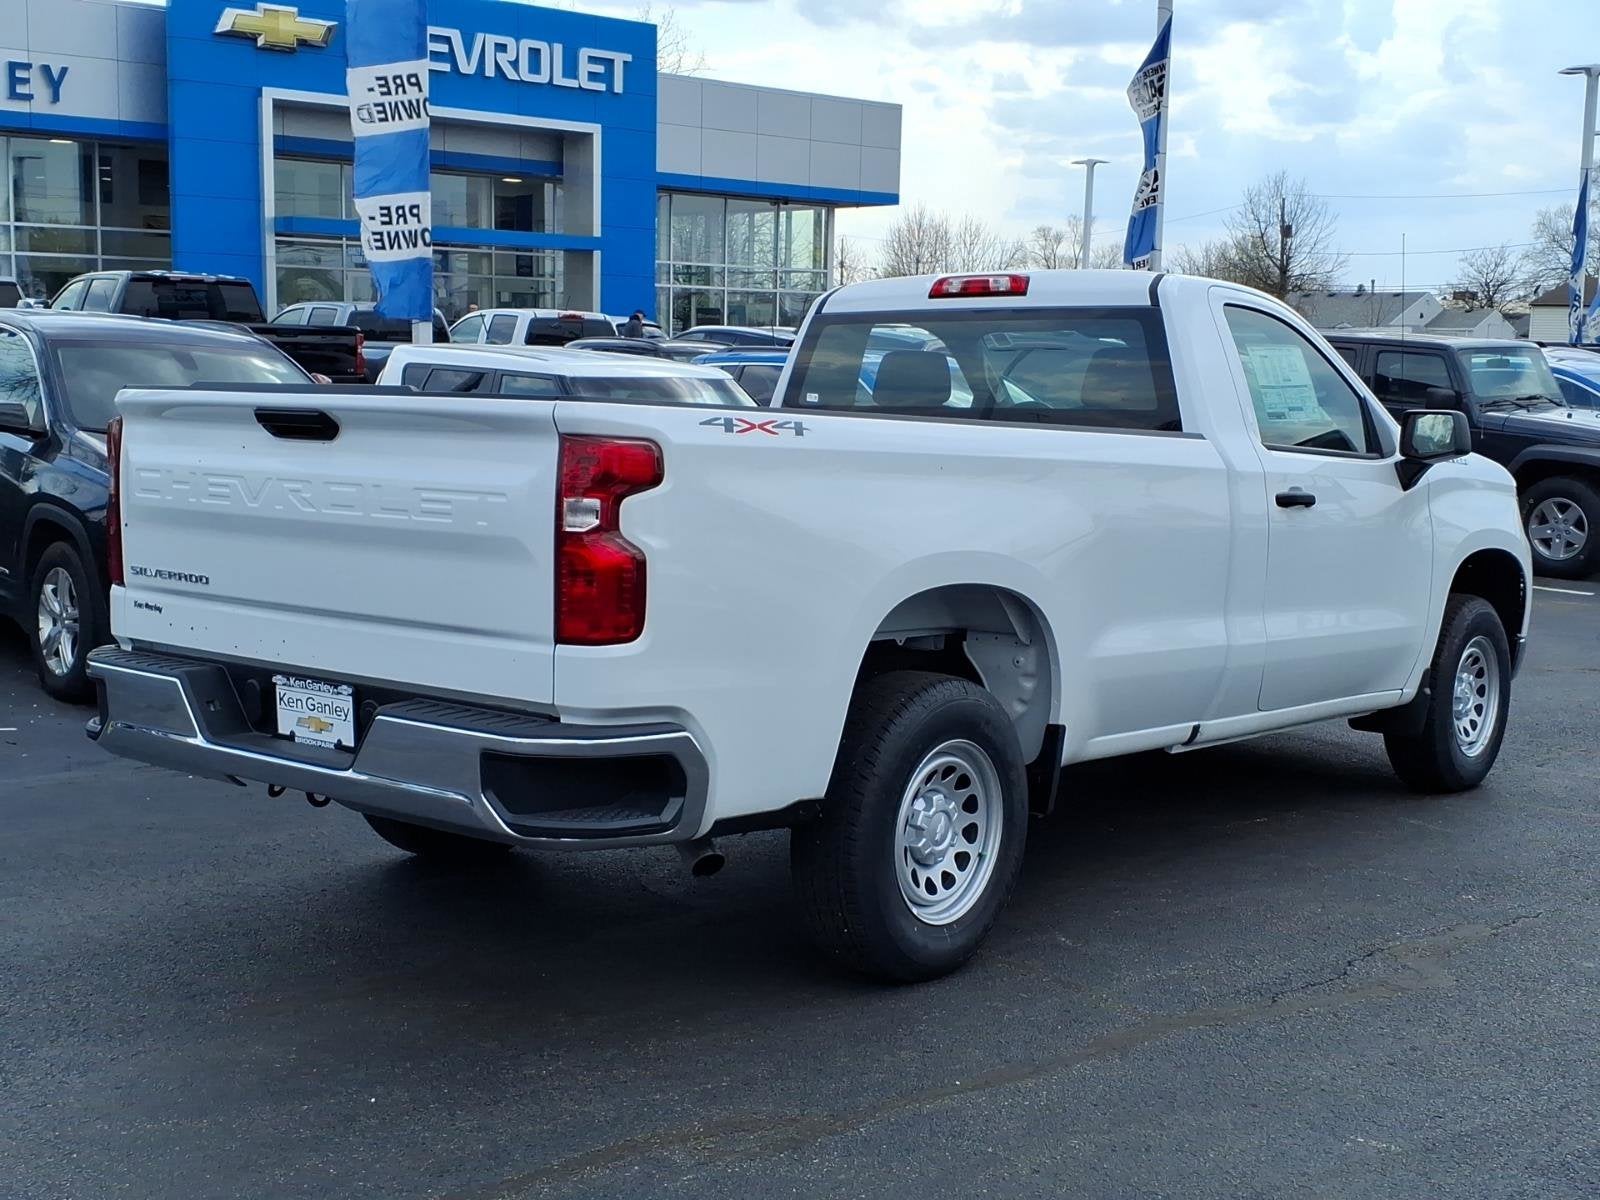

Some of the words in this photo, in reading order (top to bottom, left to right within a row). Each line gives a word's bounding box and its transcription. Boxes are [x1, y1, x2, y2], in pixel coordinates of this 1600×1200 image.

[134, 468, 508, 526] CHEVROLET
[130, 565, 210, 585] SILVERADO
[289, 677, 304, 688] Ken
[306, 680, 334, 695] Ganley
[278, 691, 303, 709] Ken
[305, 696, 350, 722] Ganley
